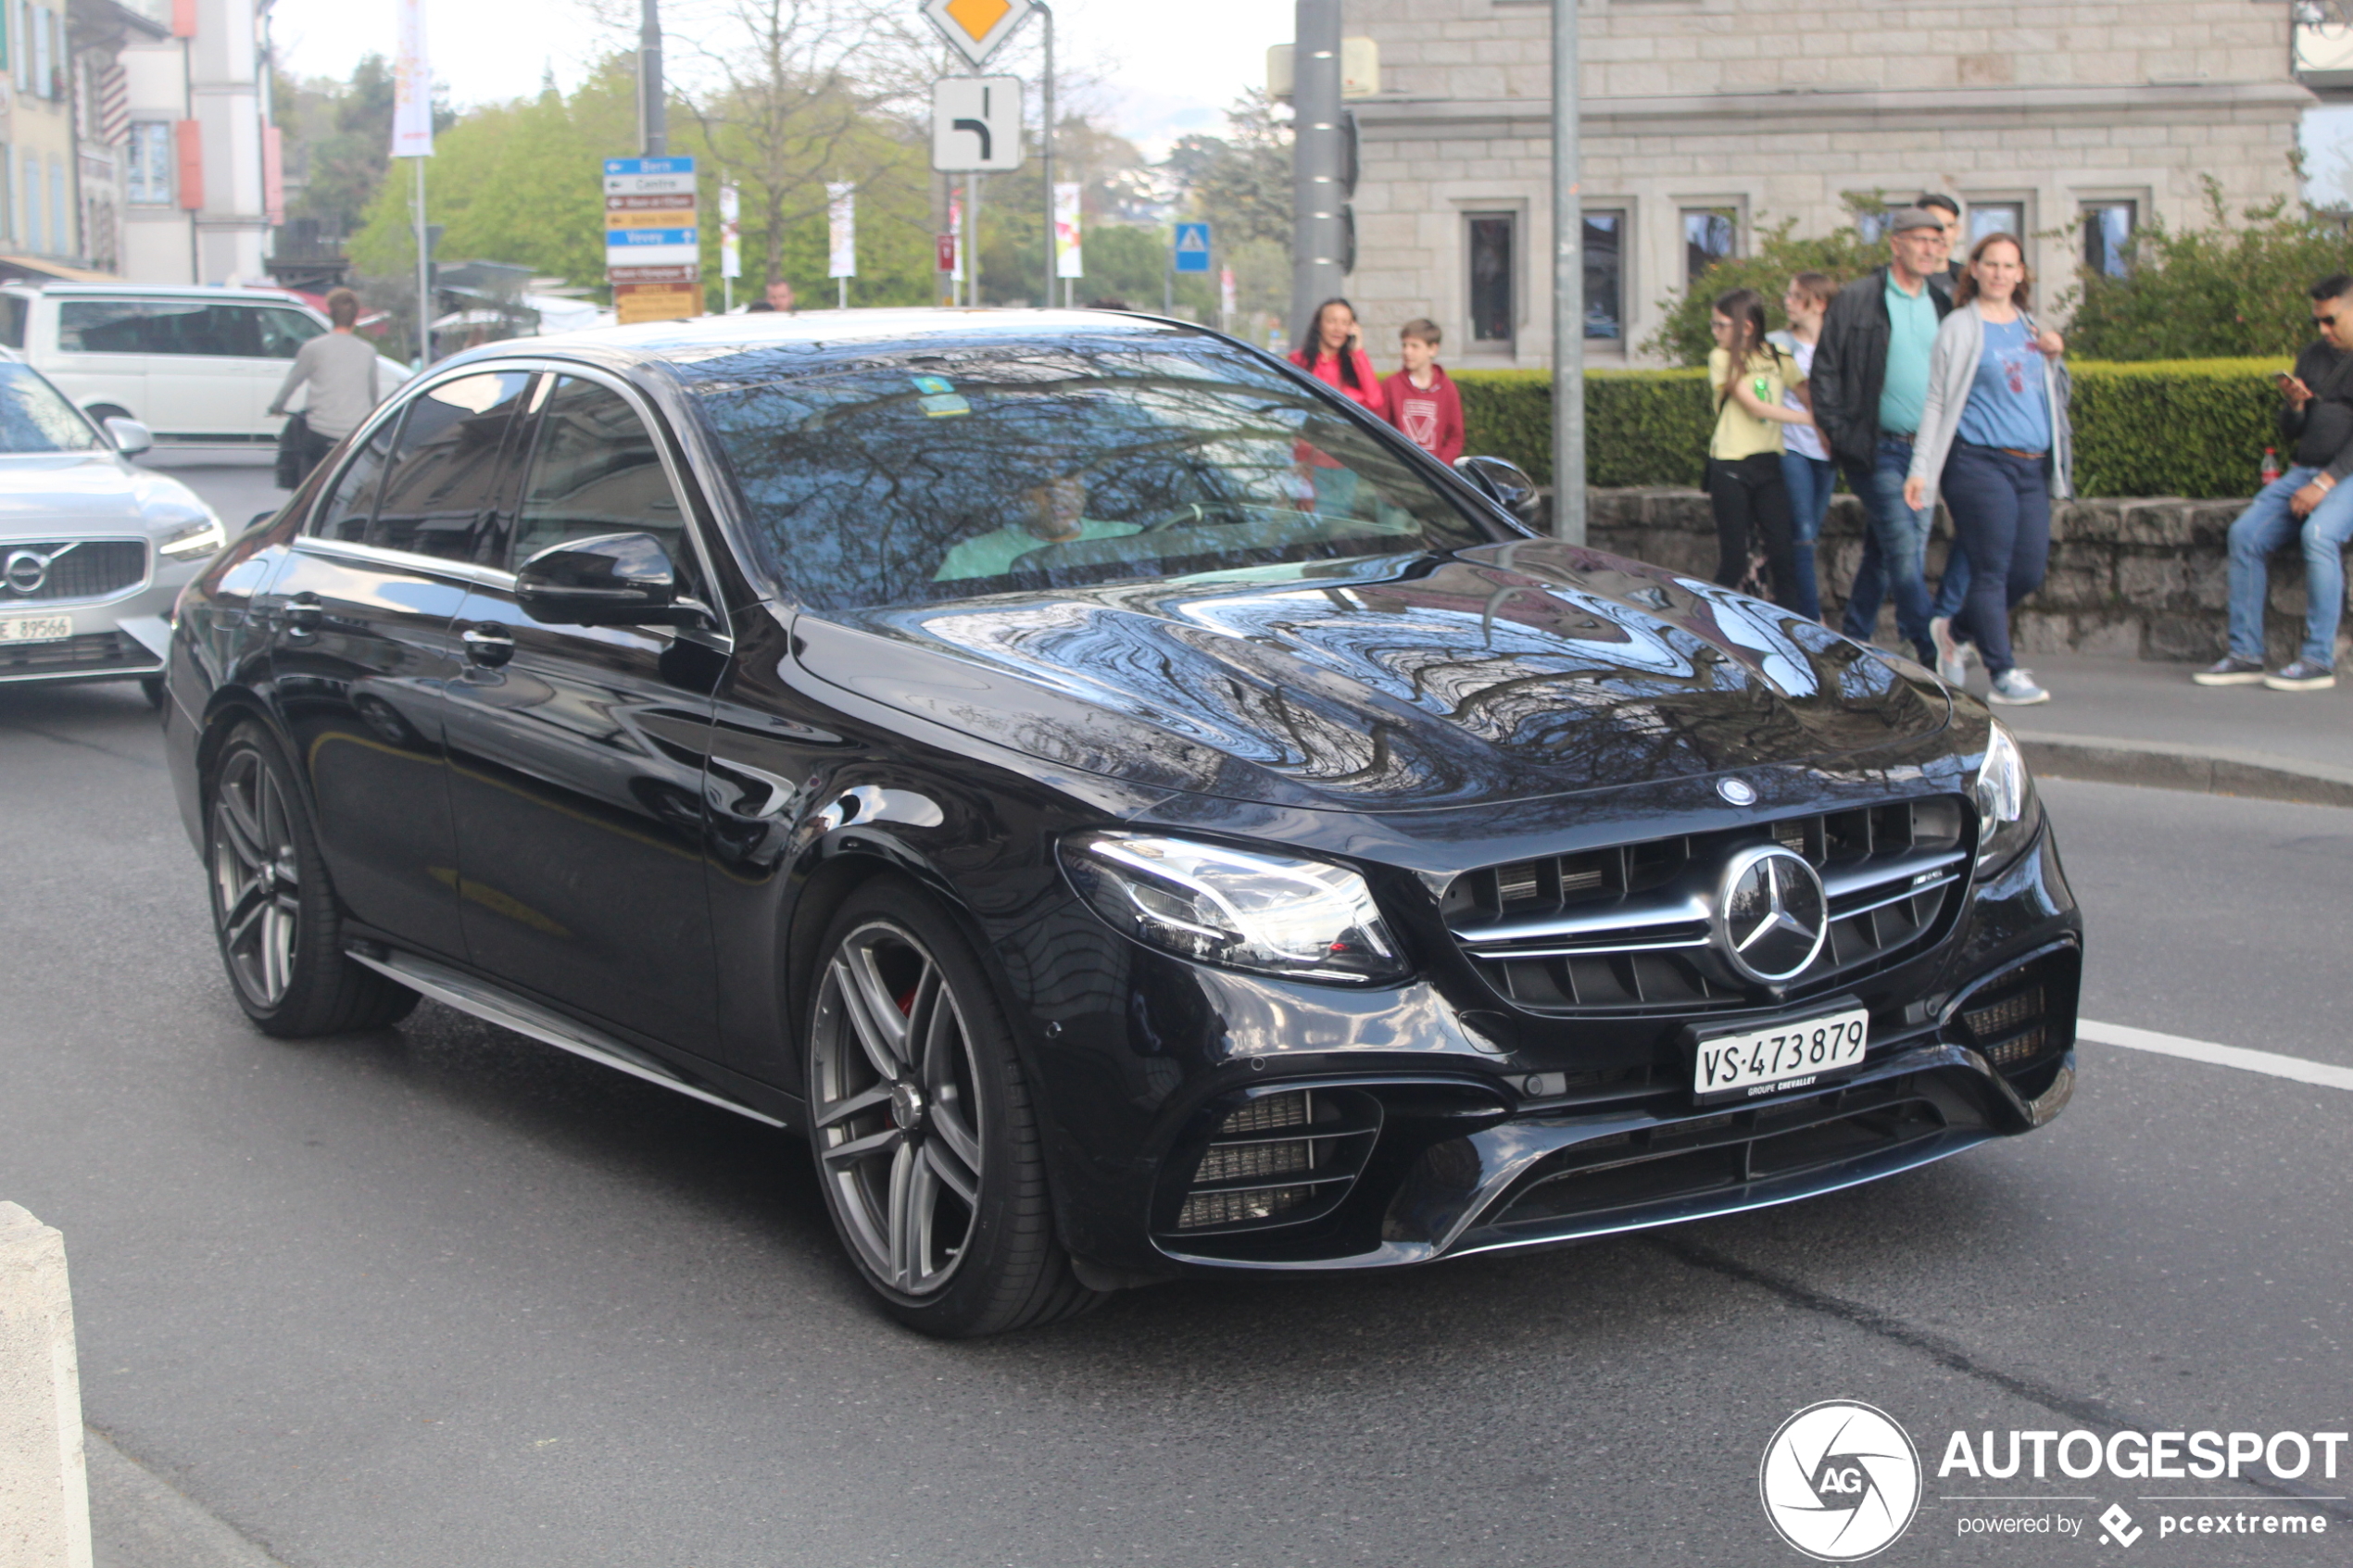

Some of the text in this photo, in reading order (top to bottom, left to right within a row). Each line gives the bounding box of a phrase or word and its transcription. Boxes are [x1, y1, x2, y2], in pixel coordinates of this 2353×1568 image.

[640, 160, 672, 173] Bern
[635, 178, 676, 190] Centre
[625, 231, 664, 245] Vevey
[1748, 1076, 1817, 1096] GROUPE CHEVALLEY
